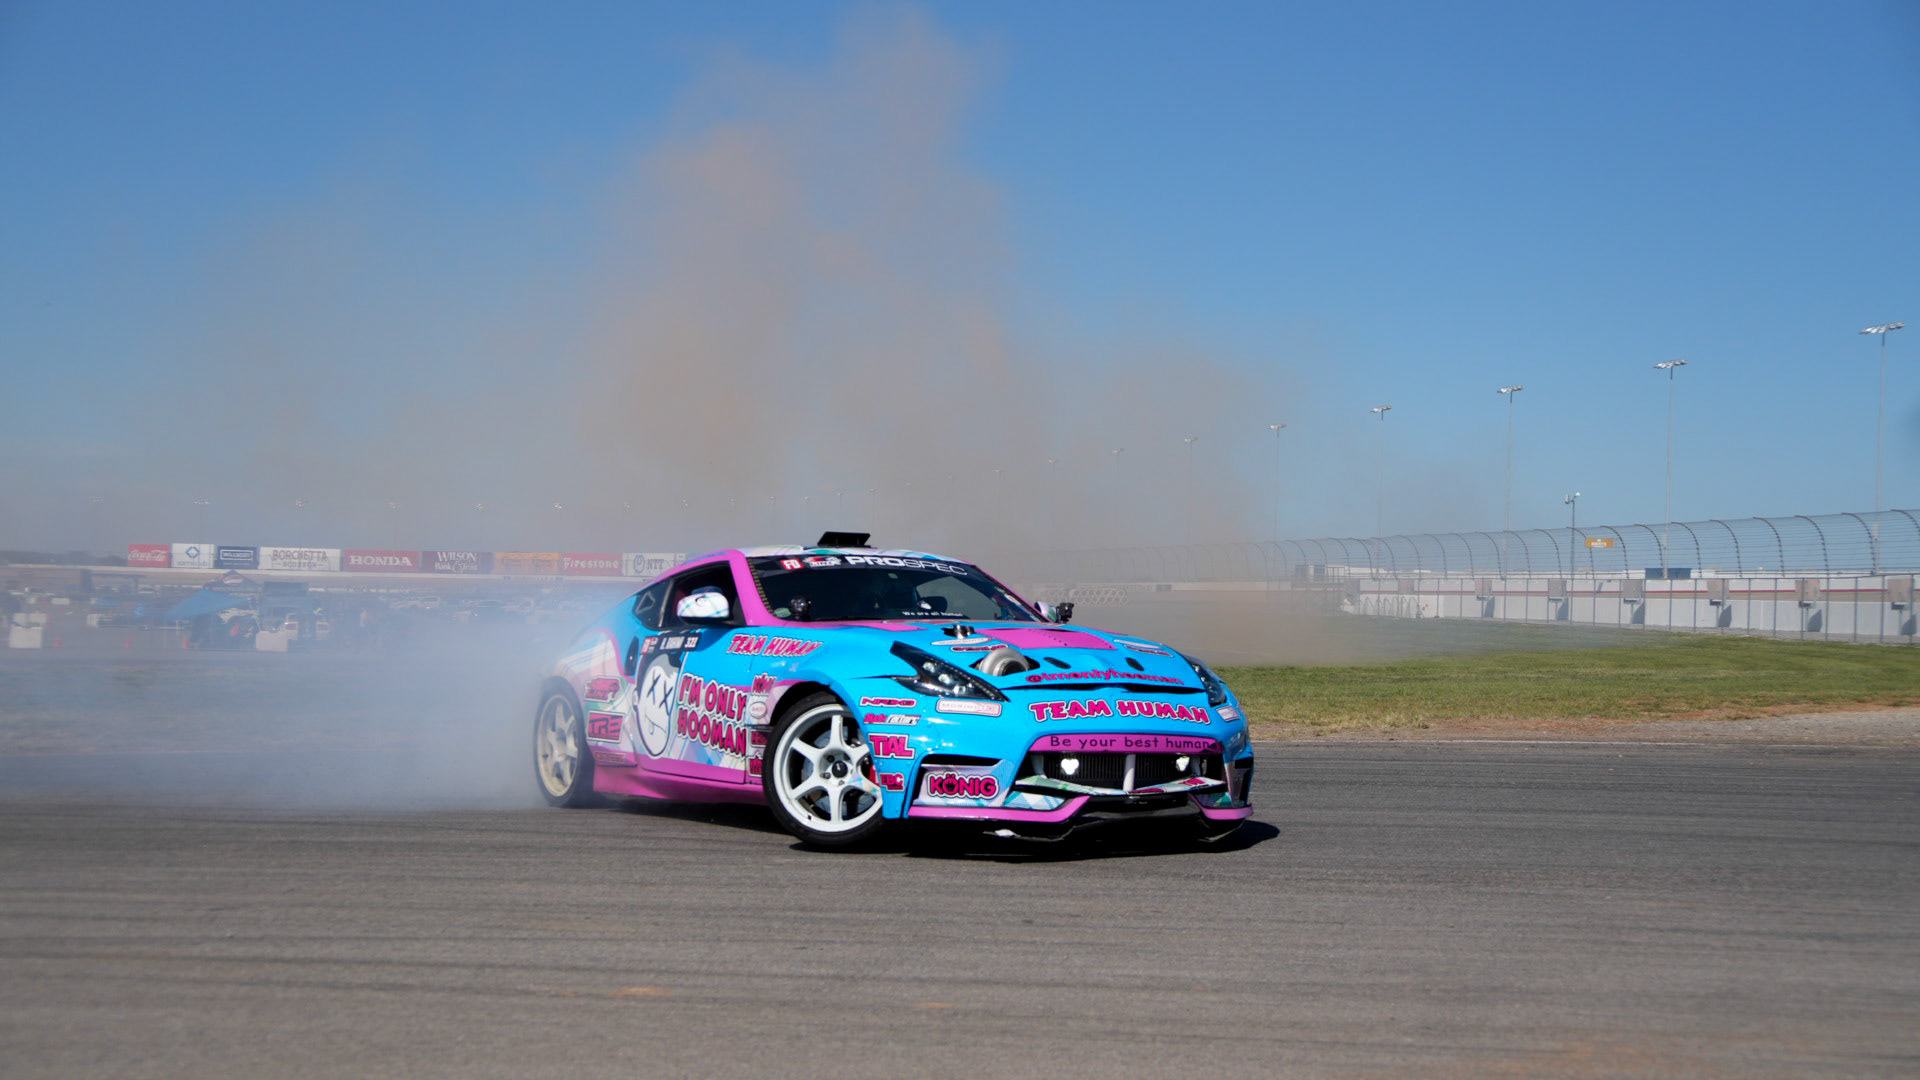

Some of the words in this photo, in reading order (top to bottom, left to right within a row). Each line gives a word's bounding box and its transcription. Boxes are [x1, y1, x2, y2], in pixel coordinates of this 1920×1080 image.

[272, 550, 327, 562] BORCHETTA
[350, 555, 412, 567] HONDA
[437, 552, 477, 562] WILSON
[435, 562, 451, 570] Bank
[563, 558, 618, 569] Firestone
[646, 558, 664, 570] NTT
[845, 556, 967, 576] PROSPEC
[726, 633, 768, 656] TEAM
[762, 636, 824, 658] HUMAN
[679, 674, 702, 708] I'M
[704, 680, 748, 723] ONLY
[1029, 699, 1113, 723] TEAM
[1115, 699, 1211, 725] HUMAN
[677, 706, 748, 759] HOOMAN
[1050, 736, 1071, 747] Be
[1078, 737, 1117, 749] your
[1125, 736, 1159, 748] best
[1166, 738, 1210, 749] human
[928, 772, 999, 799] KÖNIG
